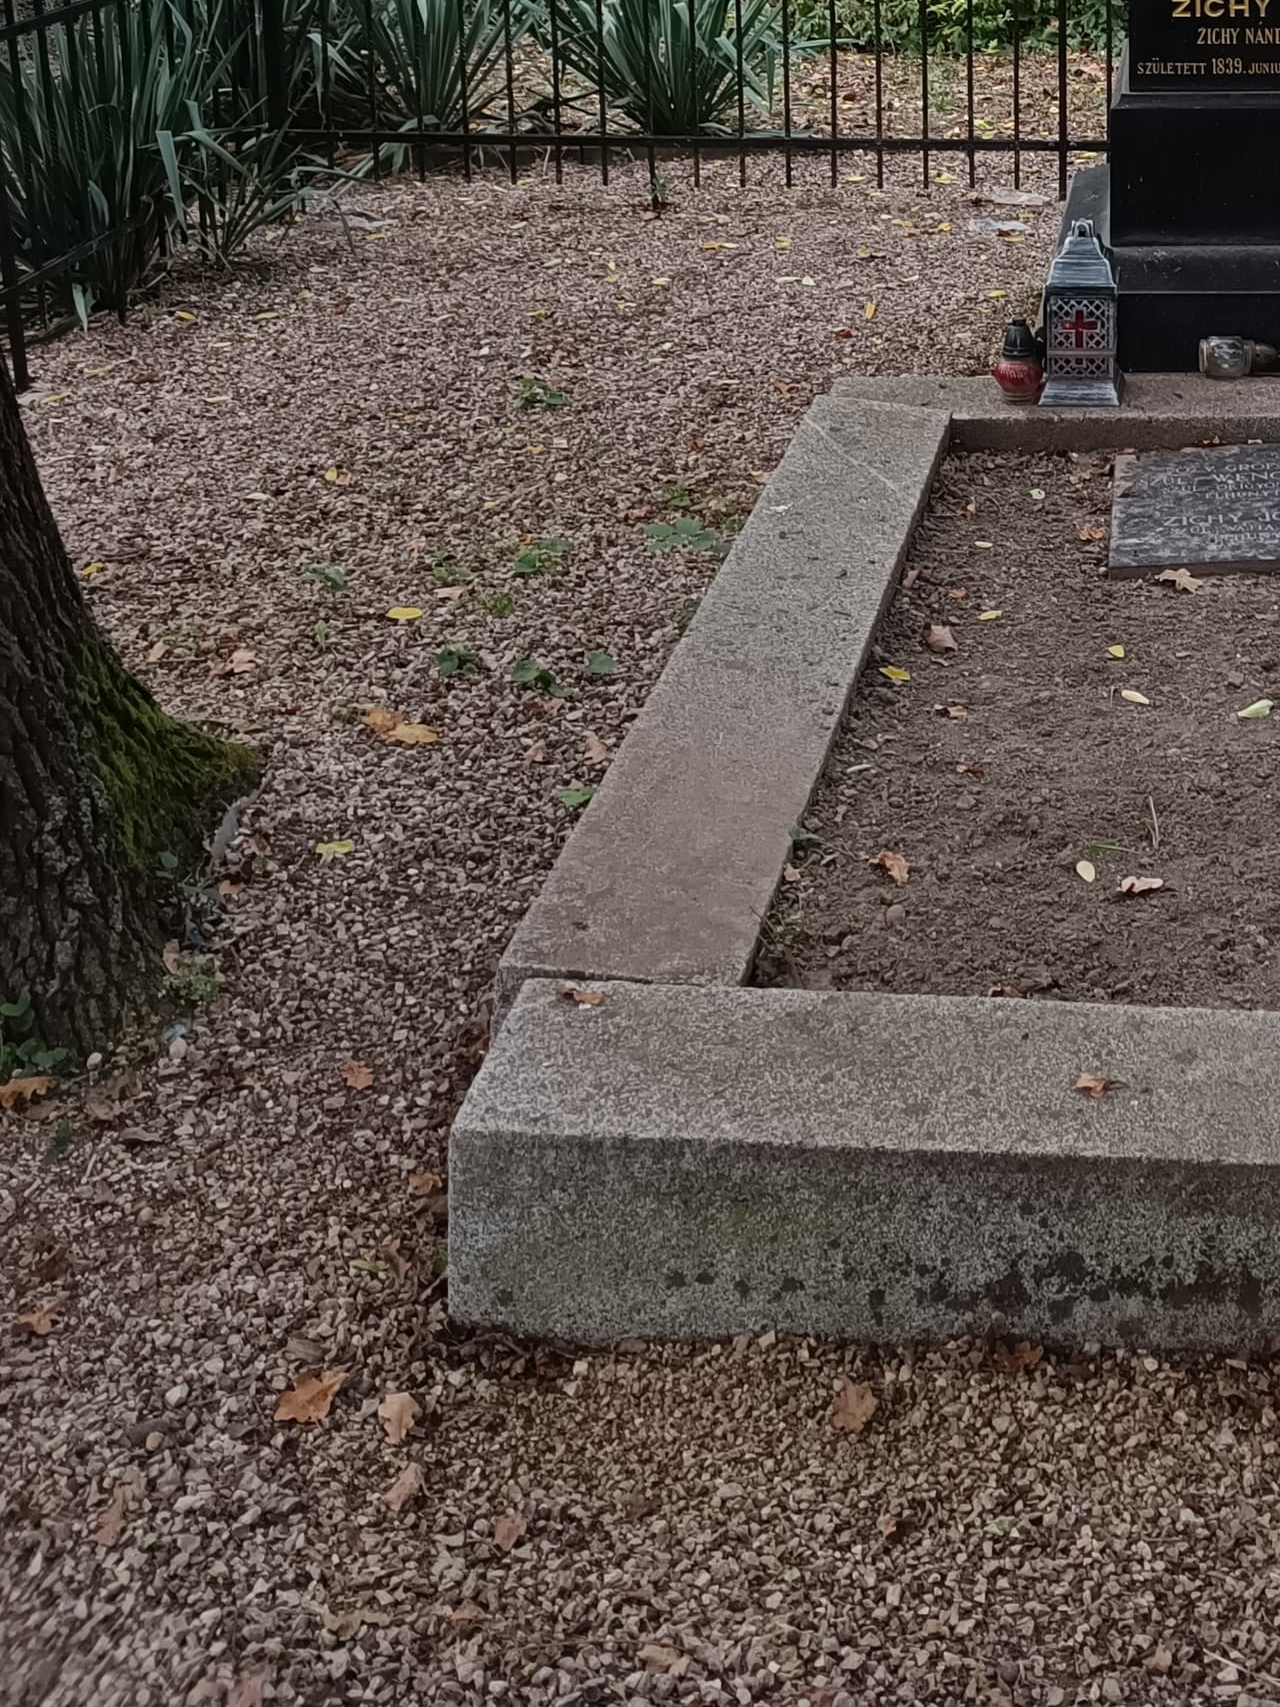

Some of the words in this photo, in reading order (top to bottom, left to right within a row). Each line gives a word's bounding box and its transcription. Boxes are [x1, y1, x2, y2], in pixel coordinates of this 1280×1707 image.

[1196, 27, 1240, 45] ZICHY
[1137, 57, 1207, 75] SZÜLETETT
[1162, 511, 1243, 526] ZICHY
